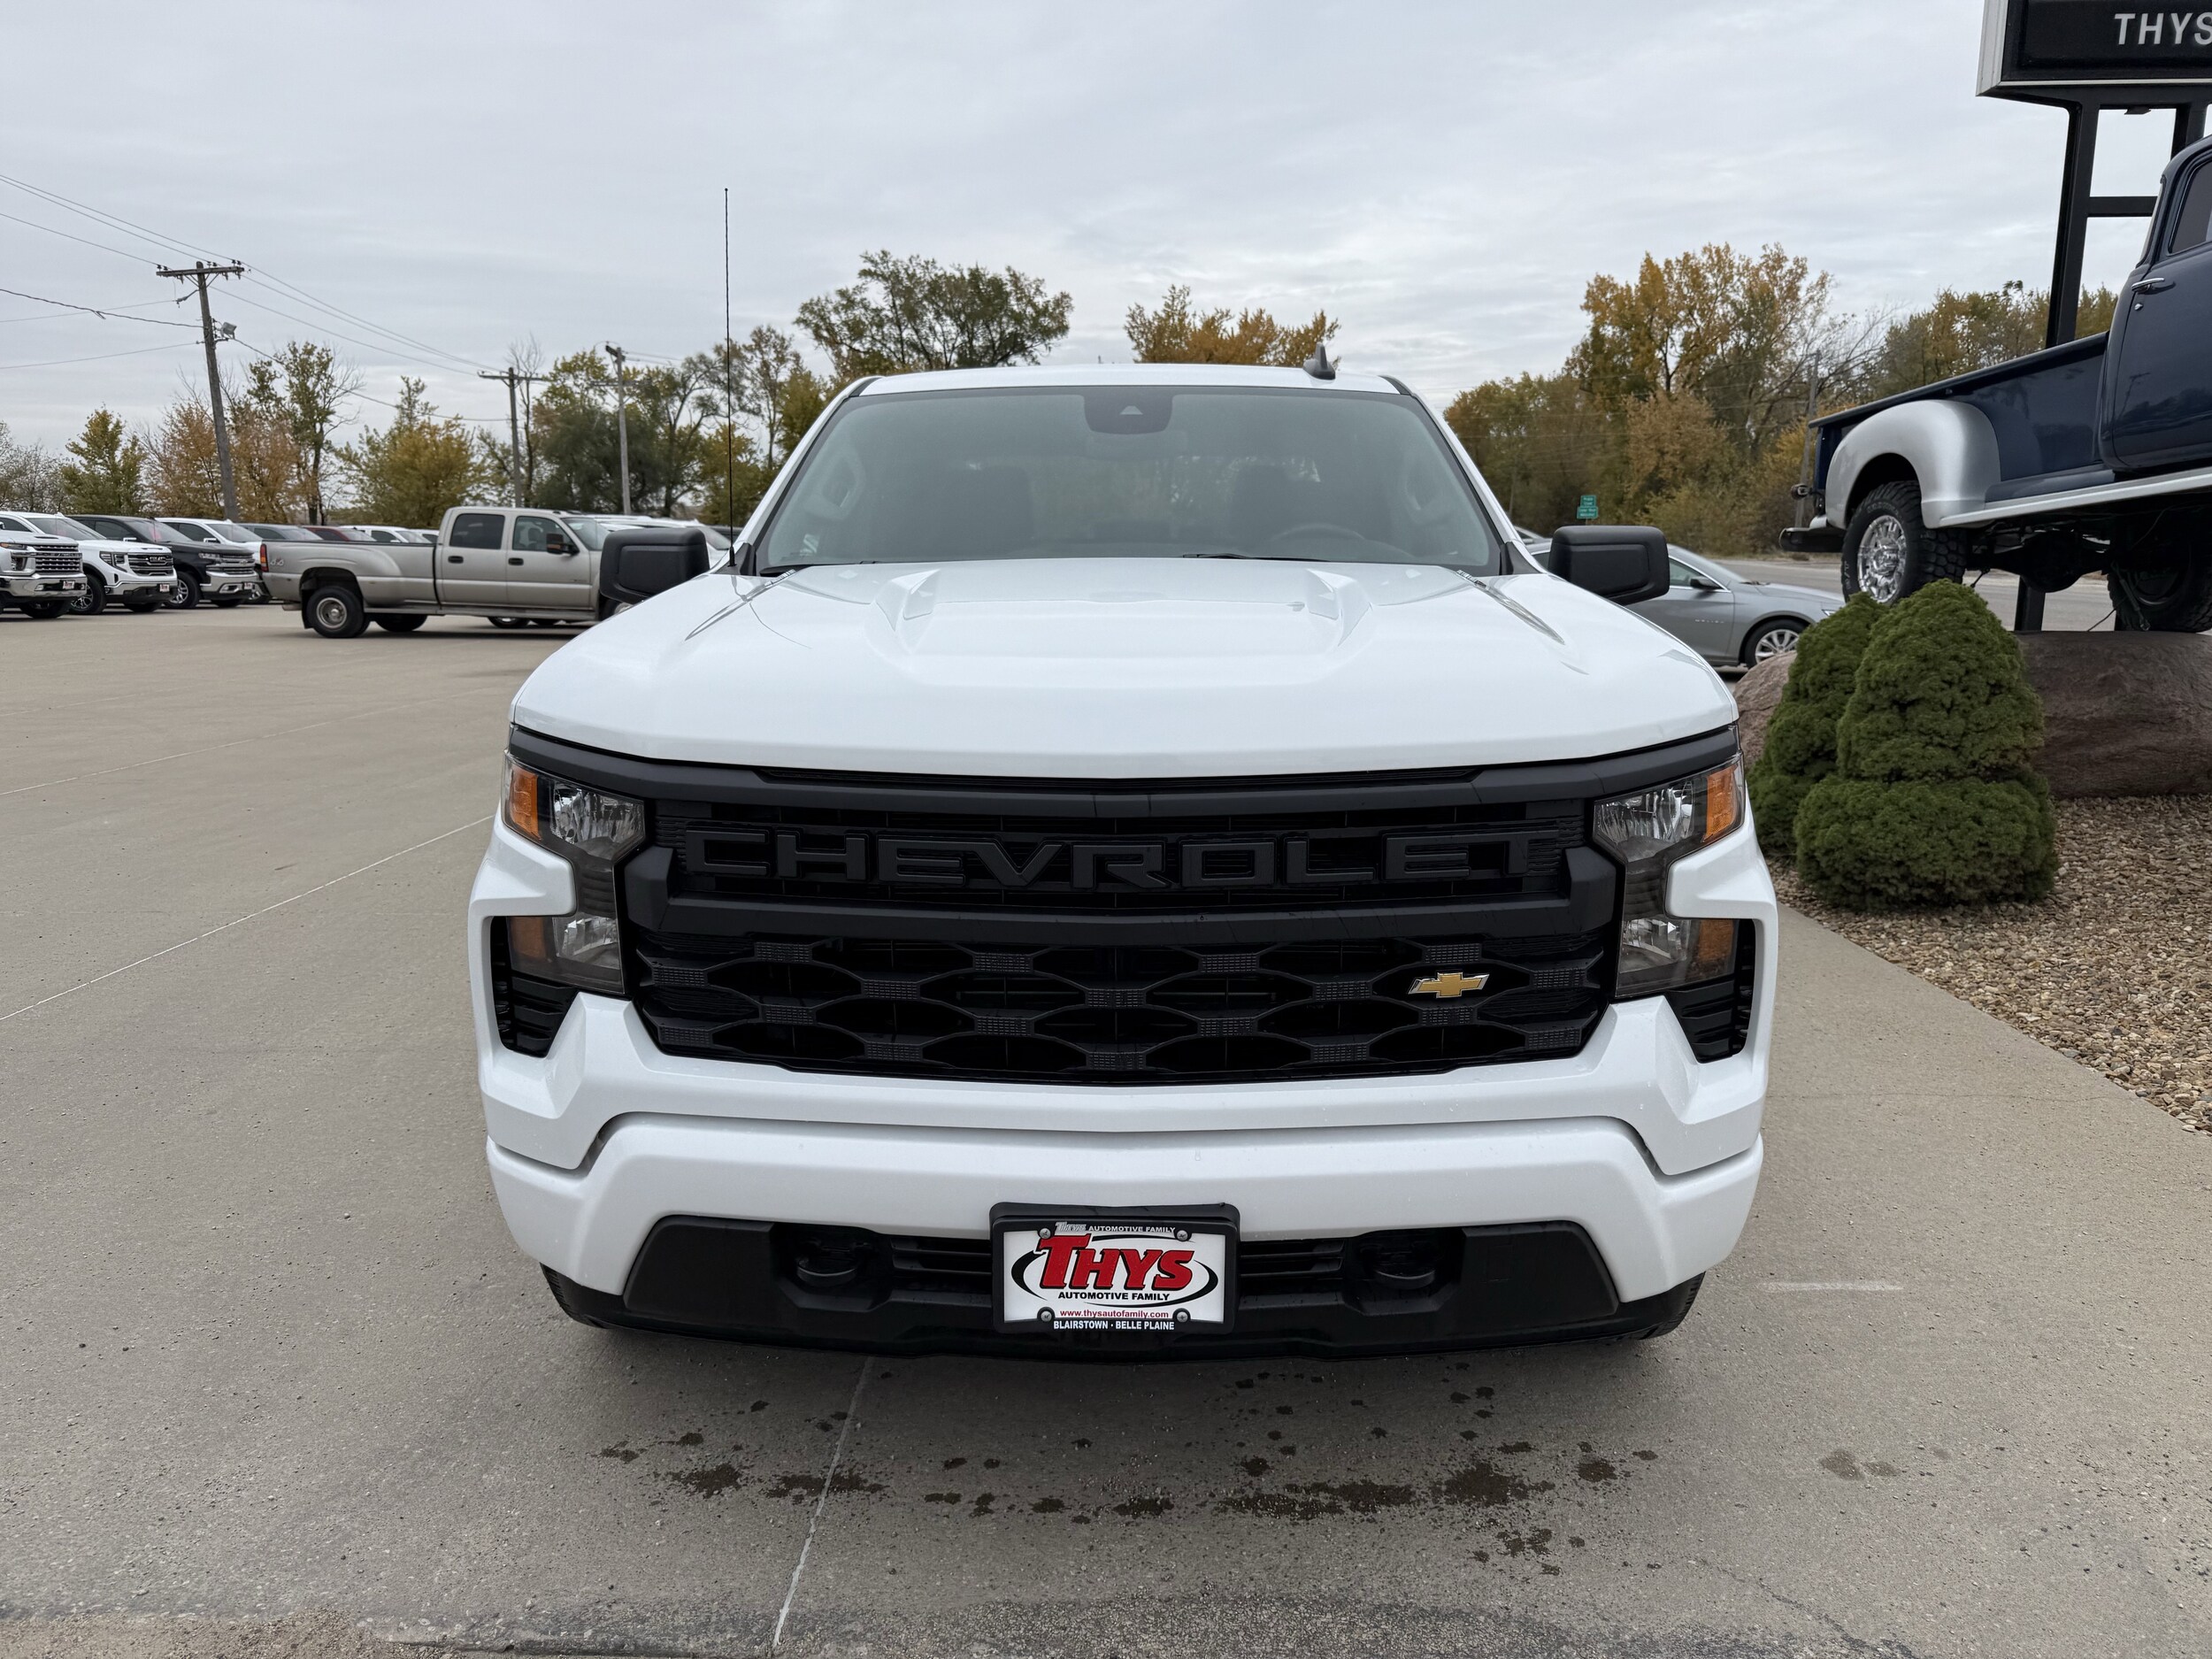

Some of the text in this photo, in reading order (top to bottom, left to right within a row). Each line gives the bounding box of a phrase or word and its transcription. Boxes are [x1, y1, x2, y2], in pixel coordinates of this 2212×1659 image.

[2114, 12, 2212, 45] THYS
[684, 827, 1562, 892] CHEVROLET
[1037, 1234, 1194, 1290] THYS
[1057, 1291, 1171, 1301] AUTOMOTIVE FAMILY
[1053, 1319, 1175, 1331] BLAIRSTOWN BELLE PLAINE
[1059, 1309, 1170, 1319] www.thysautofamily.com
